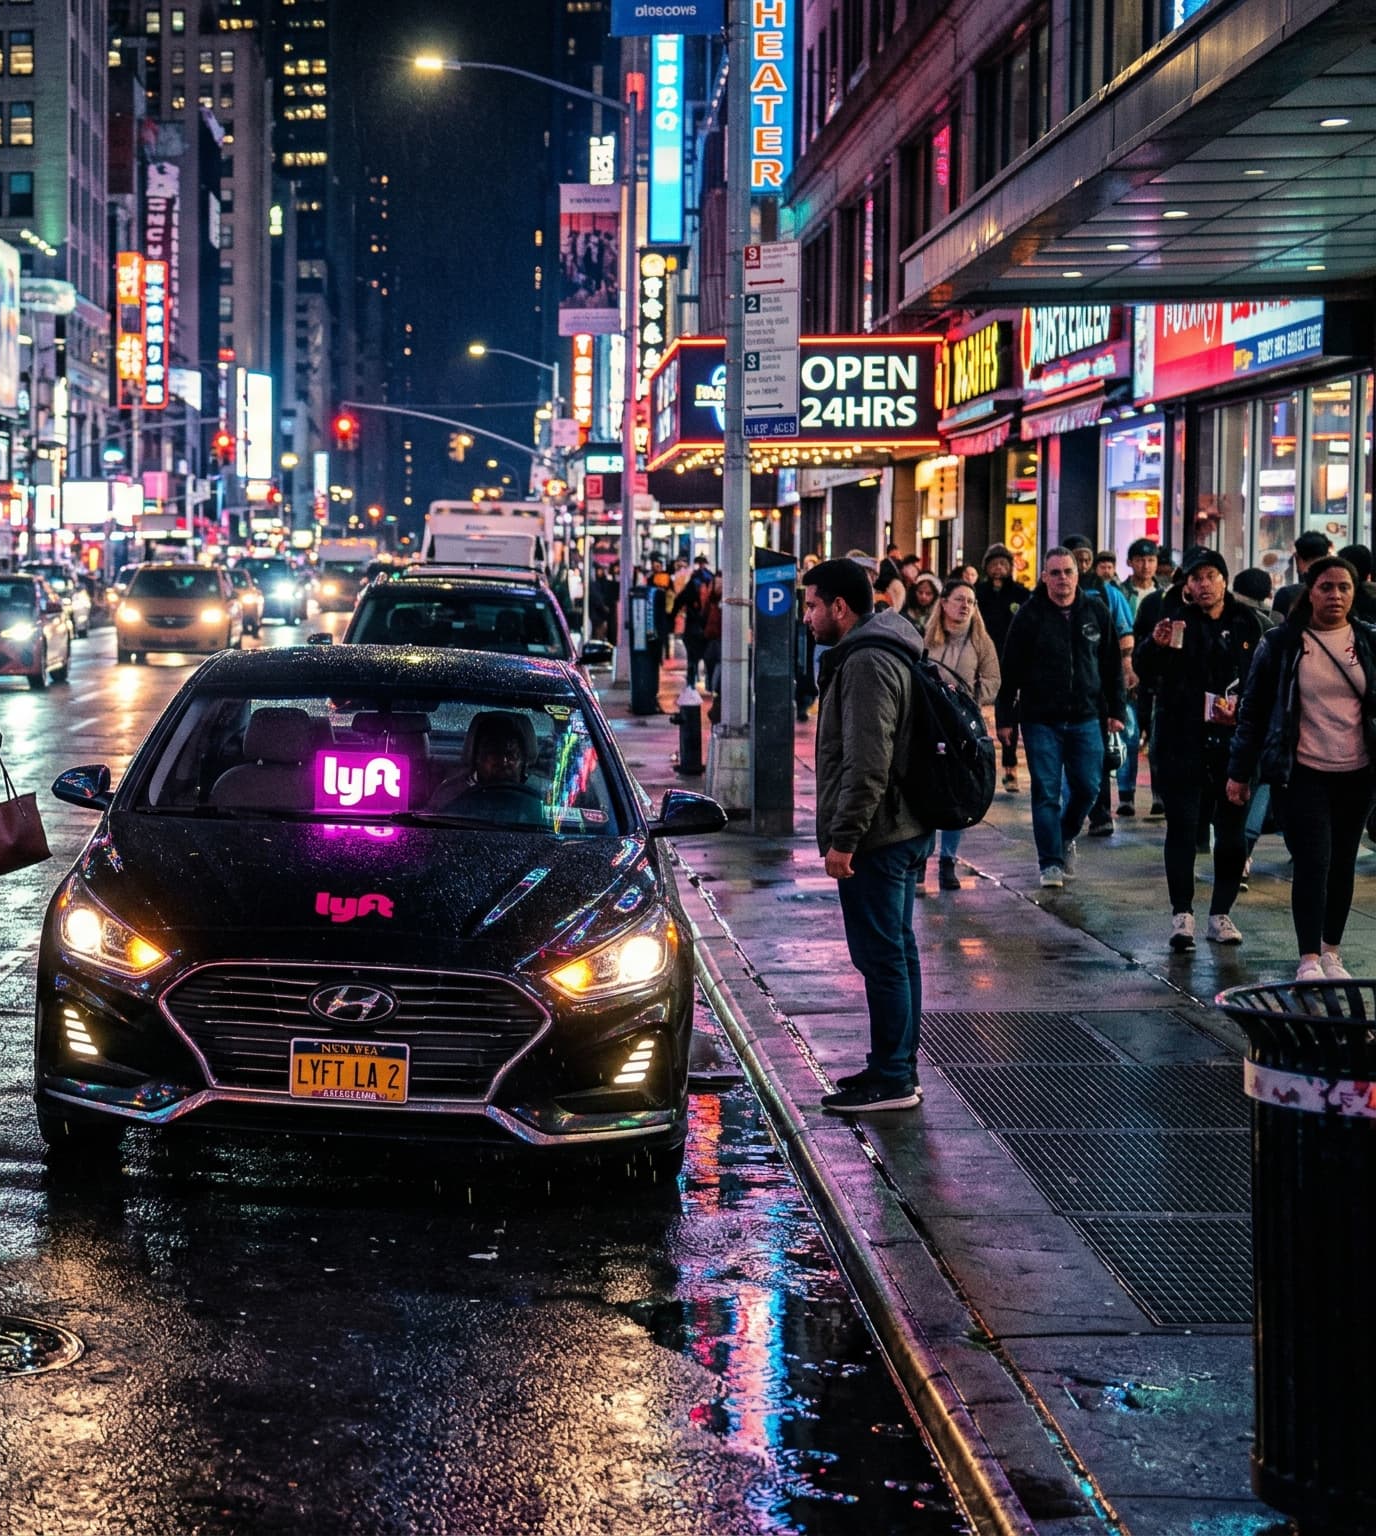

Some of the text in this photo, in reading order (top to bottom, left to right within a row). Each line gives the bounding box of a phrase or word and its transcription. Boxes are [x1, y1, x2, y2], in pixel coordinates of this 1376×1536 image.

[751, 0, 787, 188] HEATER
[747, 296, 758, 311] 2
[800, 354, 918, 391] OPEN
[800, 396, 918, 428] 24HRS
[768, 588, 784, 611] P
[324, 756, 401, 806] lyft
[316, 892, 394, 922] lyft
[297, 1059, 399, 1089] LYFT LA 2
